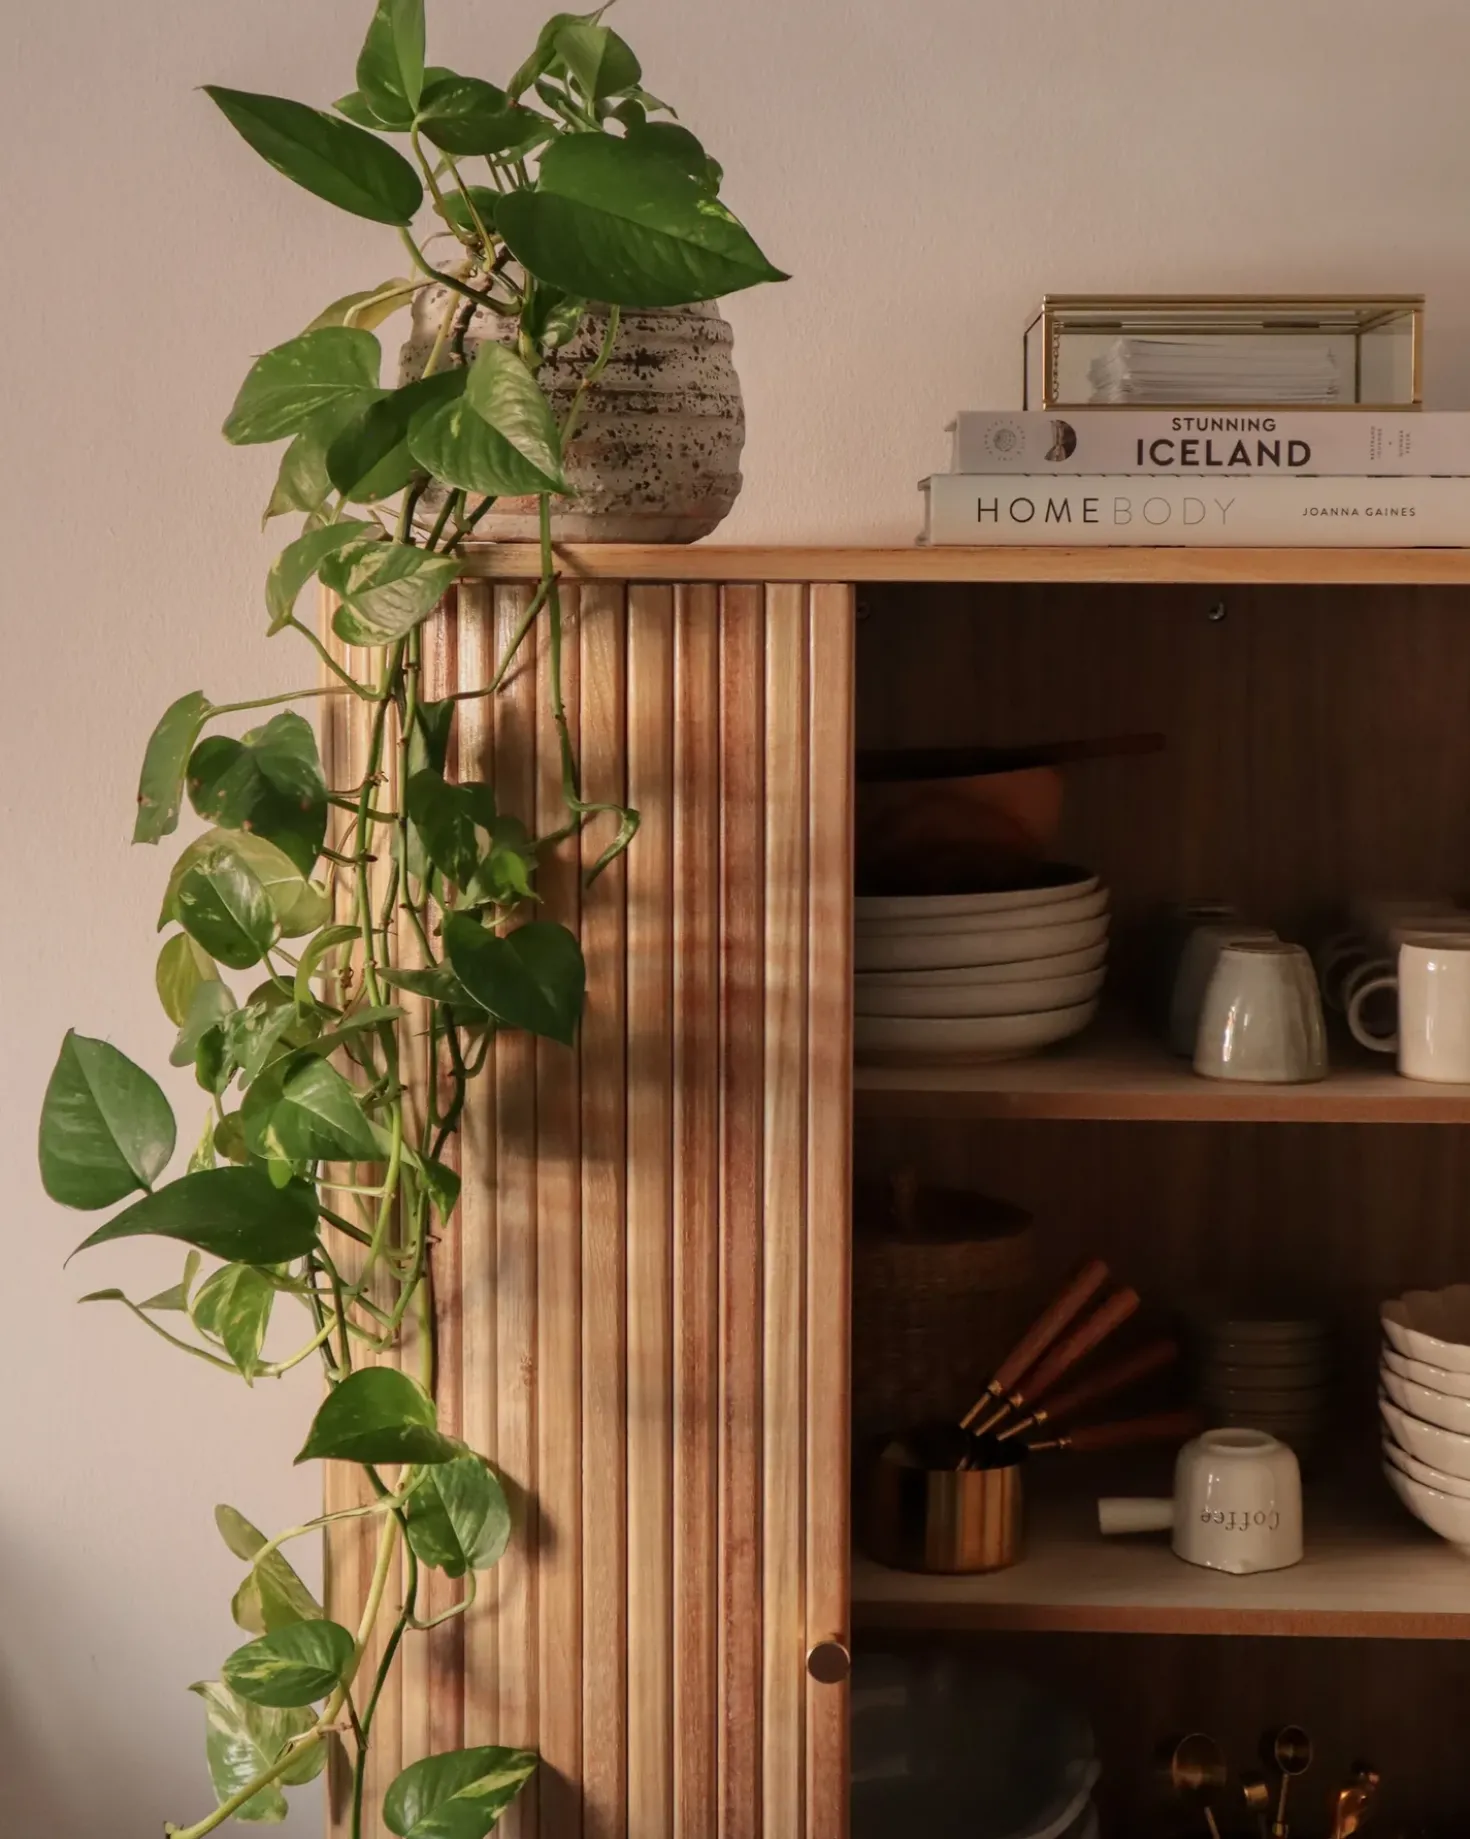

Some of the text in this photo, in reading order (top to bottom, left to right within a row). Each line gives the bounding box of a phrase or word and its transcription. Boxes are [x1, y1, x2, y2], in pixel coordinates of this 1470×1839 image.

[1171, 417, 1277, 432] STUNNING
[1136, 438, 1312, 468] ICELAND
[977, 497, 1237, 525] HOMEBODY
[1302, 506, 1416, 517] JOANNA GAINES
[1199, 1509, 1281, 1532] Coffee
